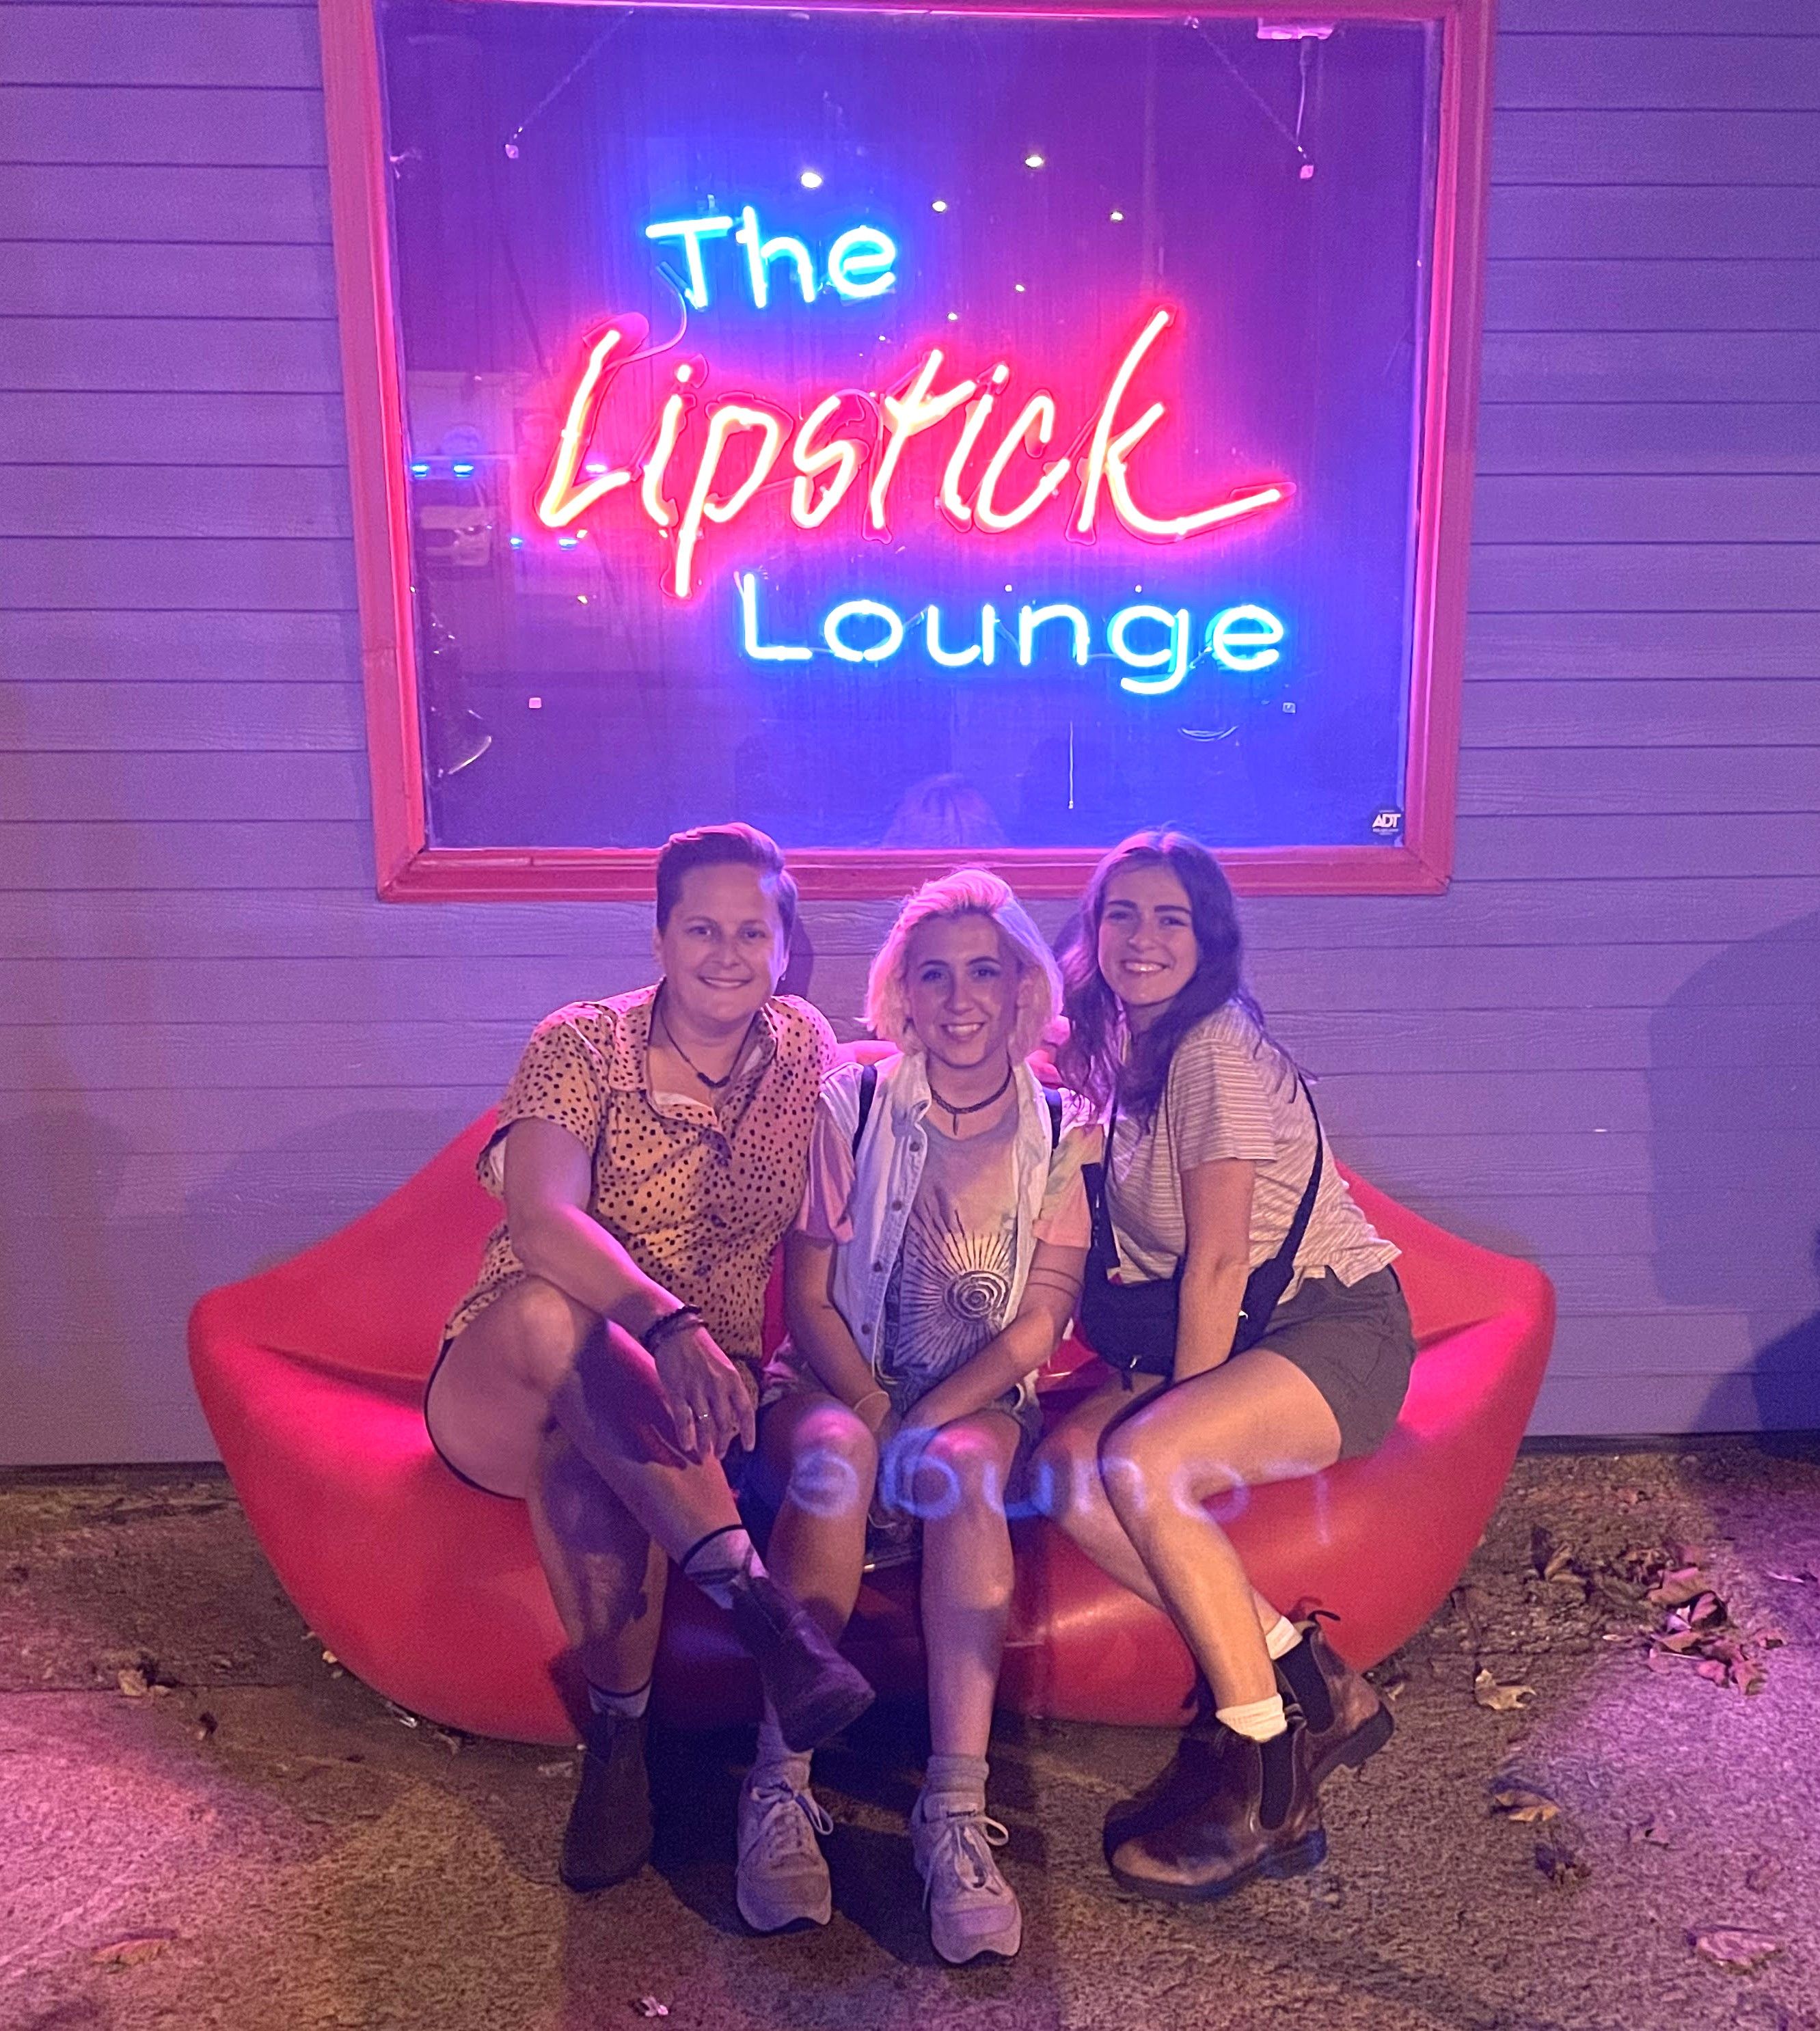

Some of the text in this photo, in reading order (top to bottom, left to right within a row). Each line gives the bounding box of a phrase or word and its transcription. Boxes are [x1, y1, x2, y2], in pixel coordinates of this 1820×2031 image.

[645, 204, 899, 311] The
[539, 310, 1281, 597] Lipstick
[739, 571, 1286, 695] Lounge
[1372, 813, 1401, 828] ADT
